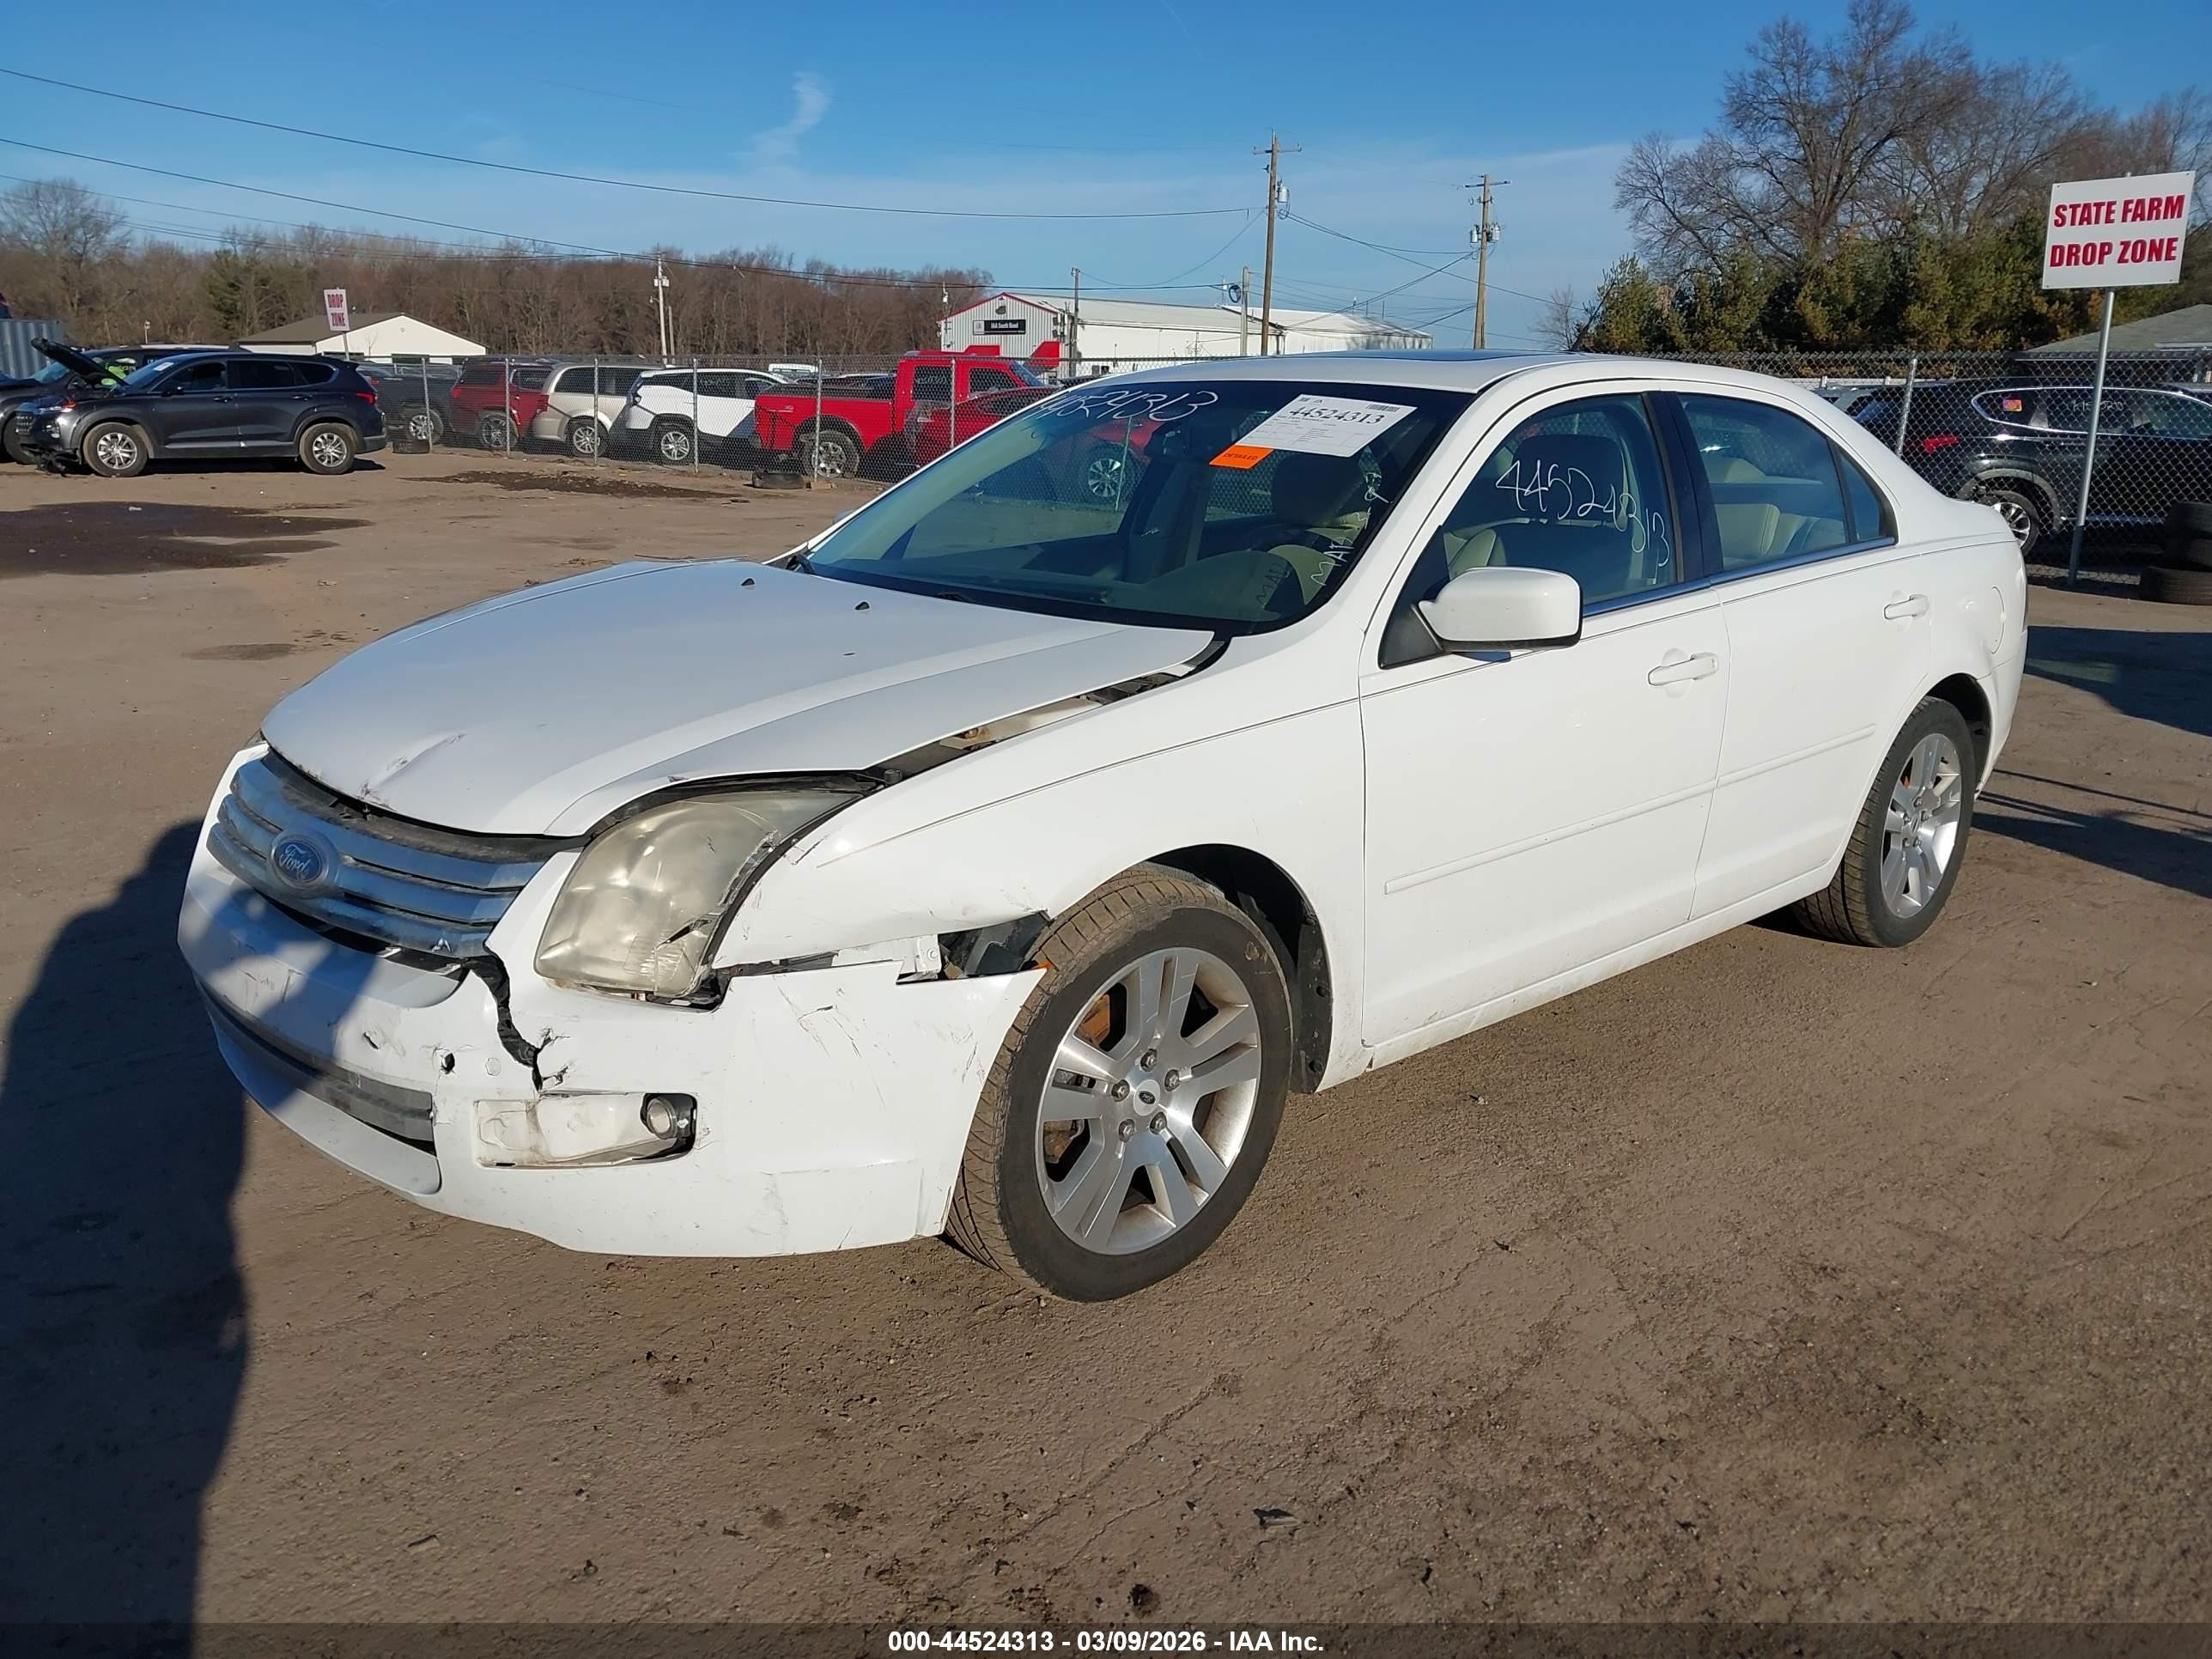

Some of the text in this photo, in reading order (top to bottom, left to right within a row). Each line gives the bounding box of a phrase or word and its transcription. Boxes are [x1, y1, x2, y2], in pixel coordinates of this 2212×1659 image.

[2053, 194, 2185, 228] STATE FARM
[2049, 237, 2179, 268] DROP ZONE
[327, 294, 343, 308] DROP
[331, 312, 346, 326] ZONE
[1289, 405, 1385, 424] 44524313
[1222, 452, 1259, 461] DETAILED
[1496, 459, 1670, 568] 44524313
[278, 844, 311, 878] Ford
